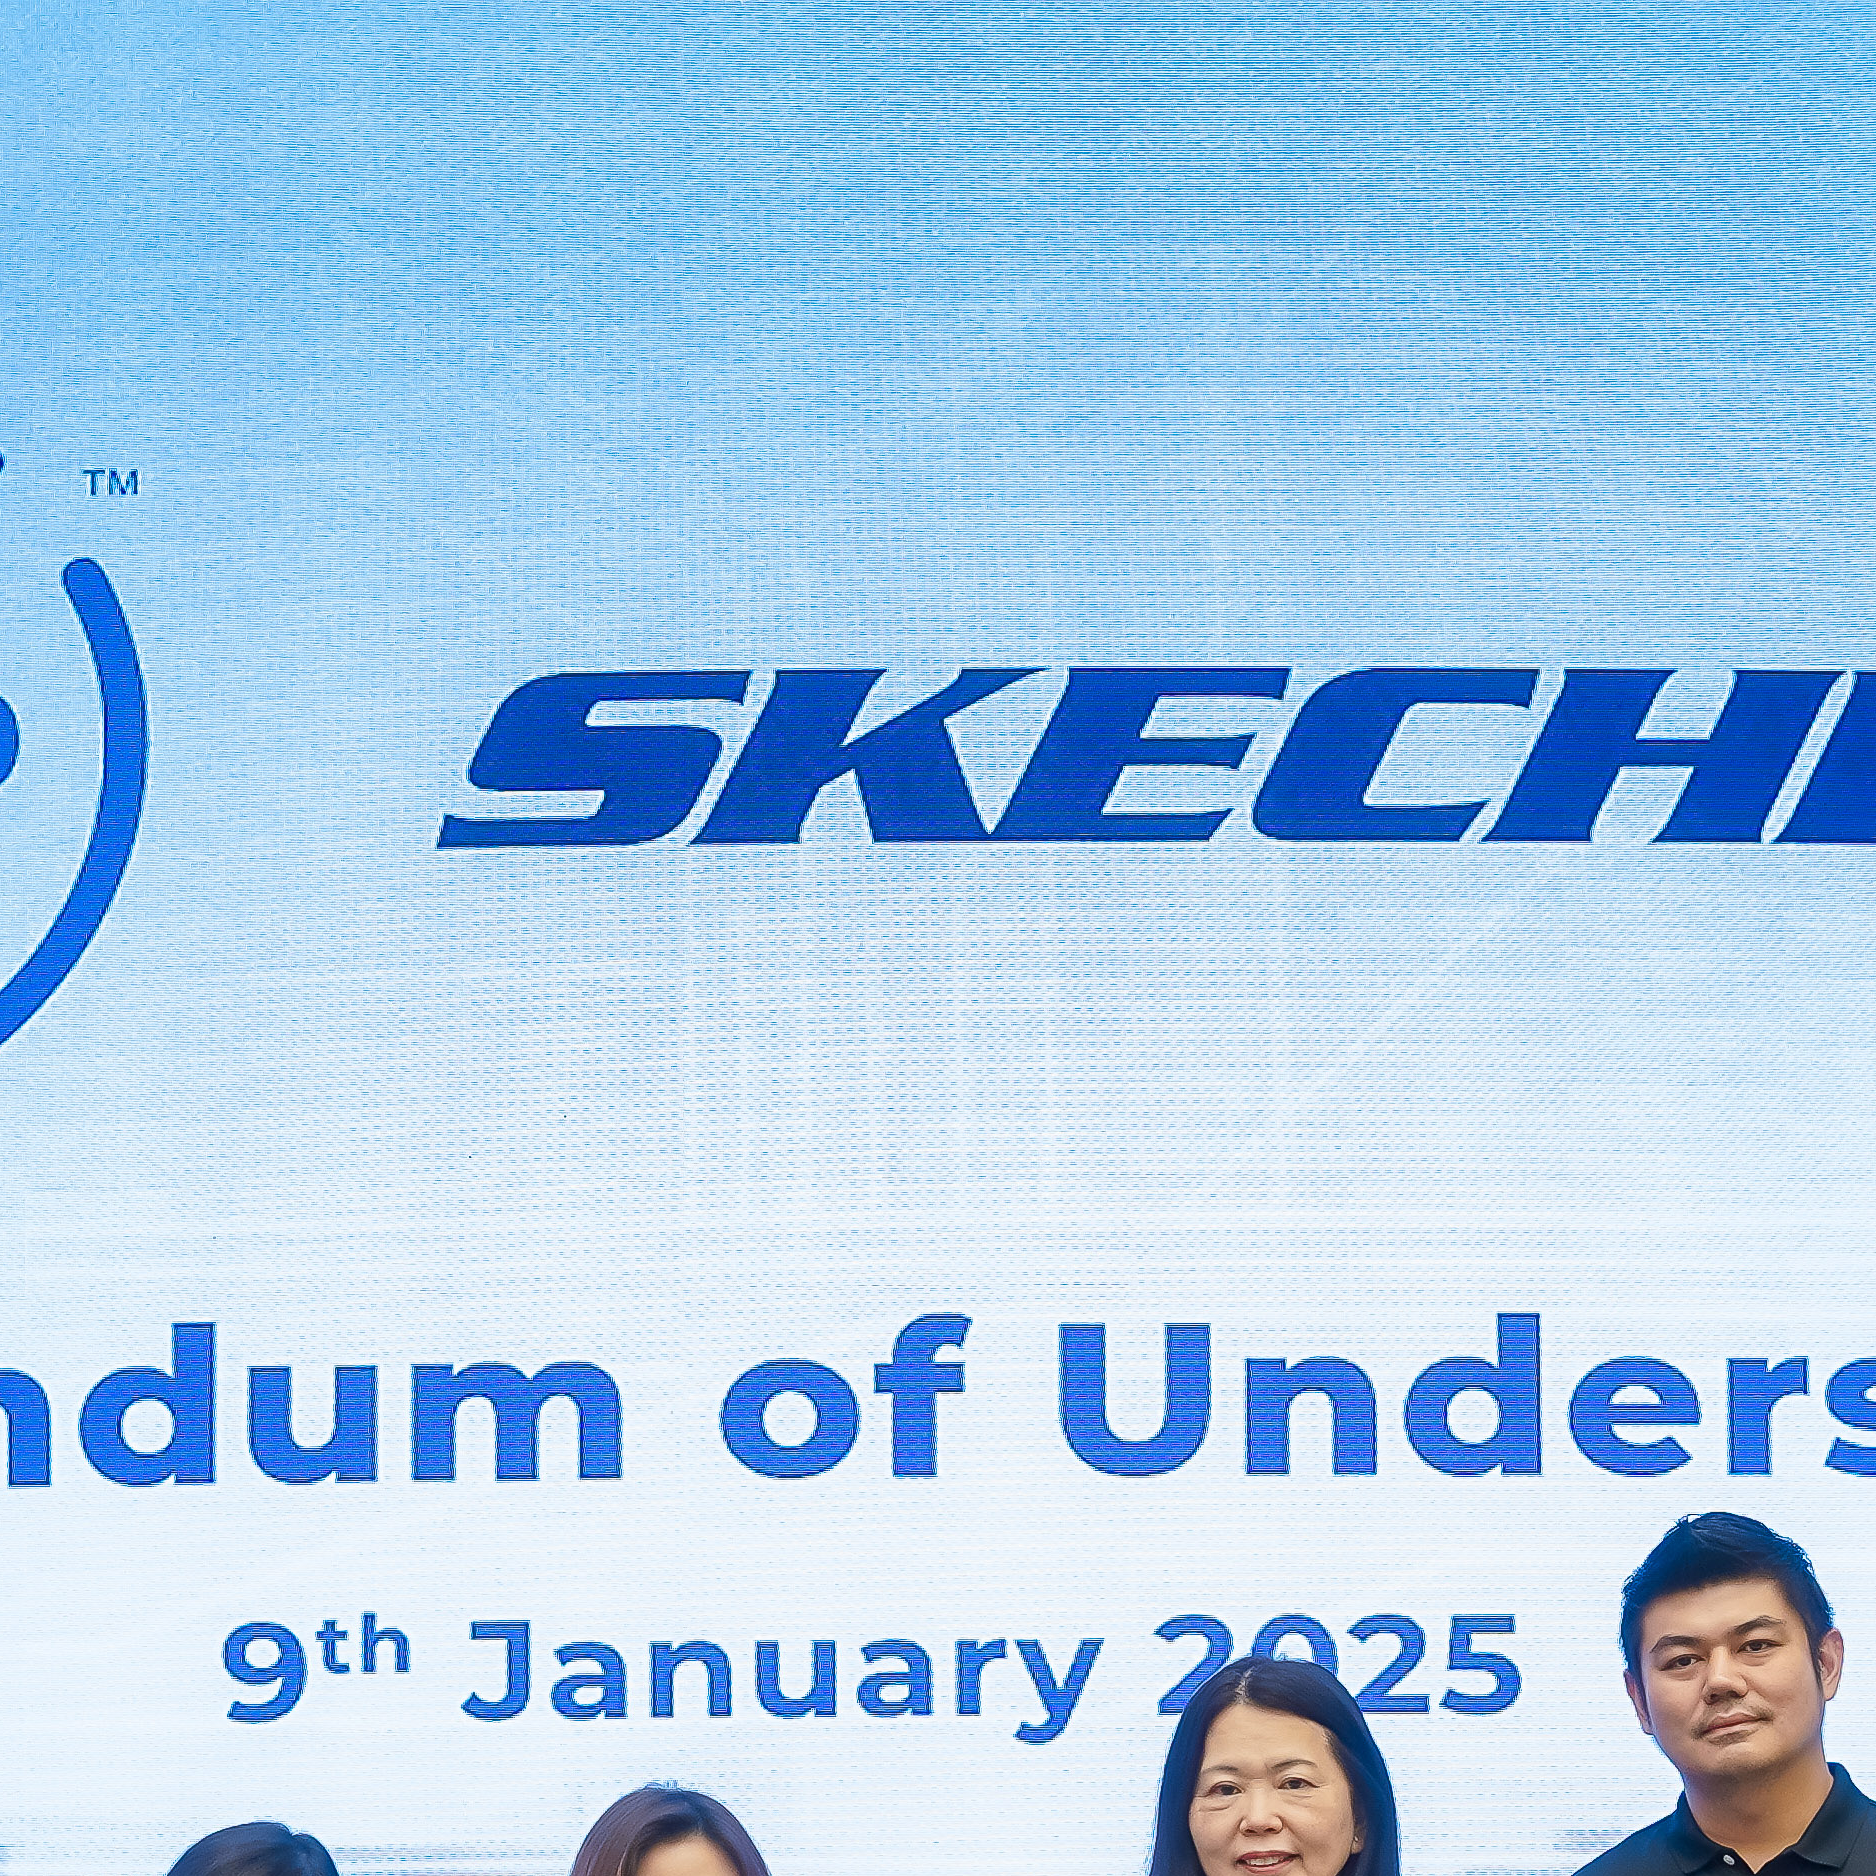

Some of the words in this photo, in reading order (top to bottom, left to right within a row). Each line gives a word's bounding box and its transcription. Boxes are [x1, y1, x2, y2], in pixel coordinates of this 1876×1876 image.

[82, 468, 139, 496] TM
[721, 1315, 972, 1480] of
[461, 1620, 1103, 1743] January
